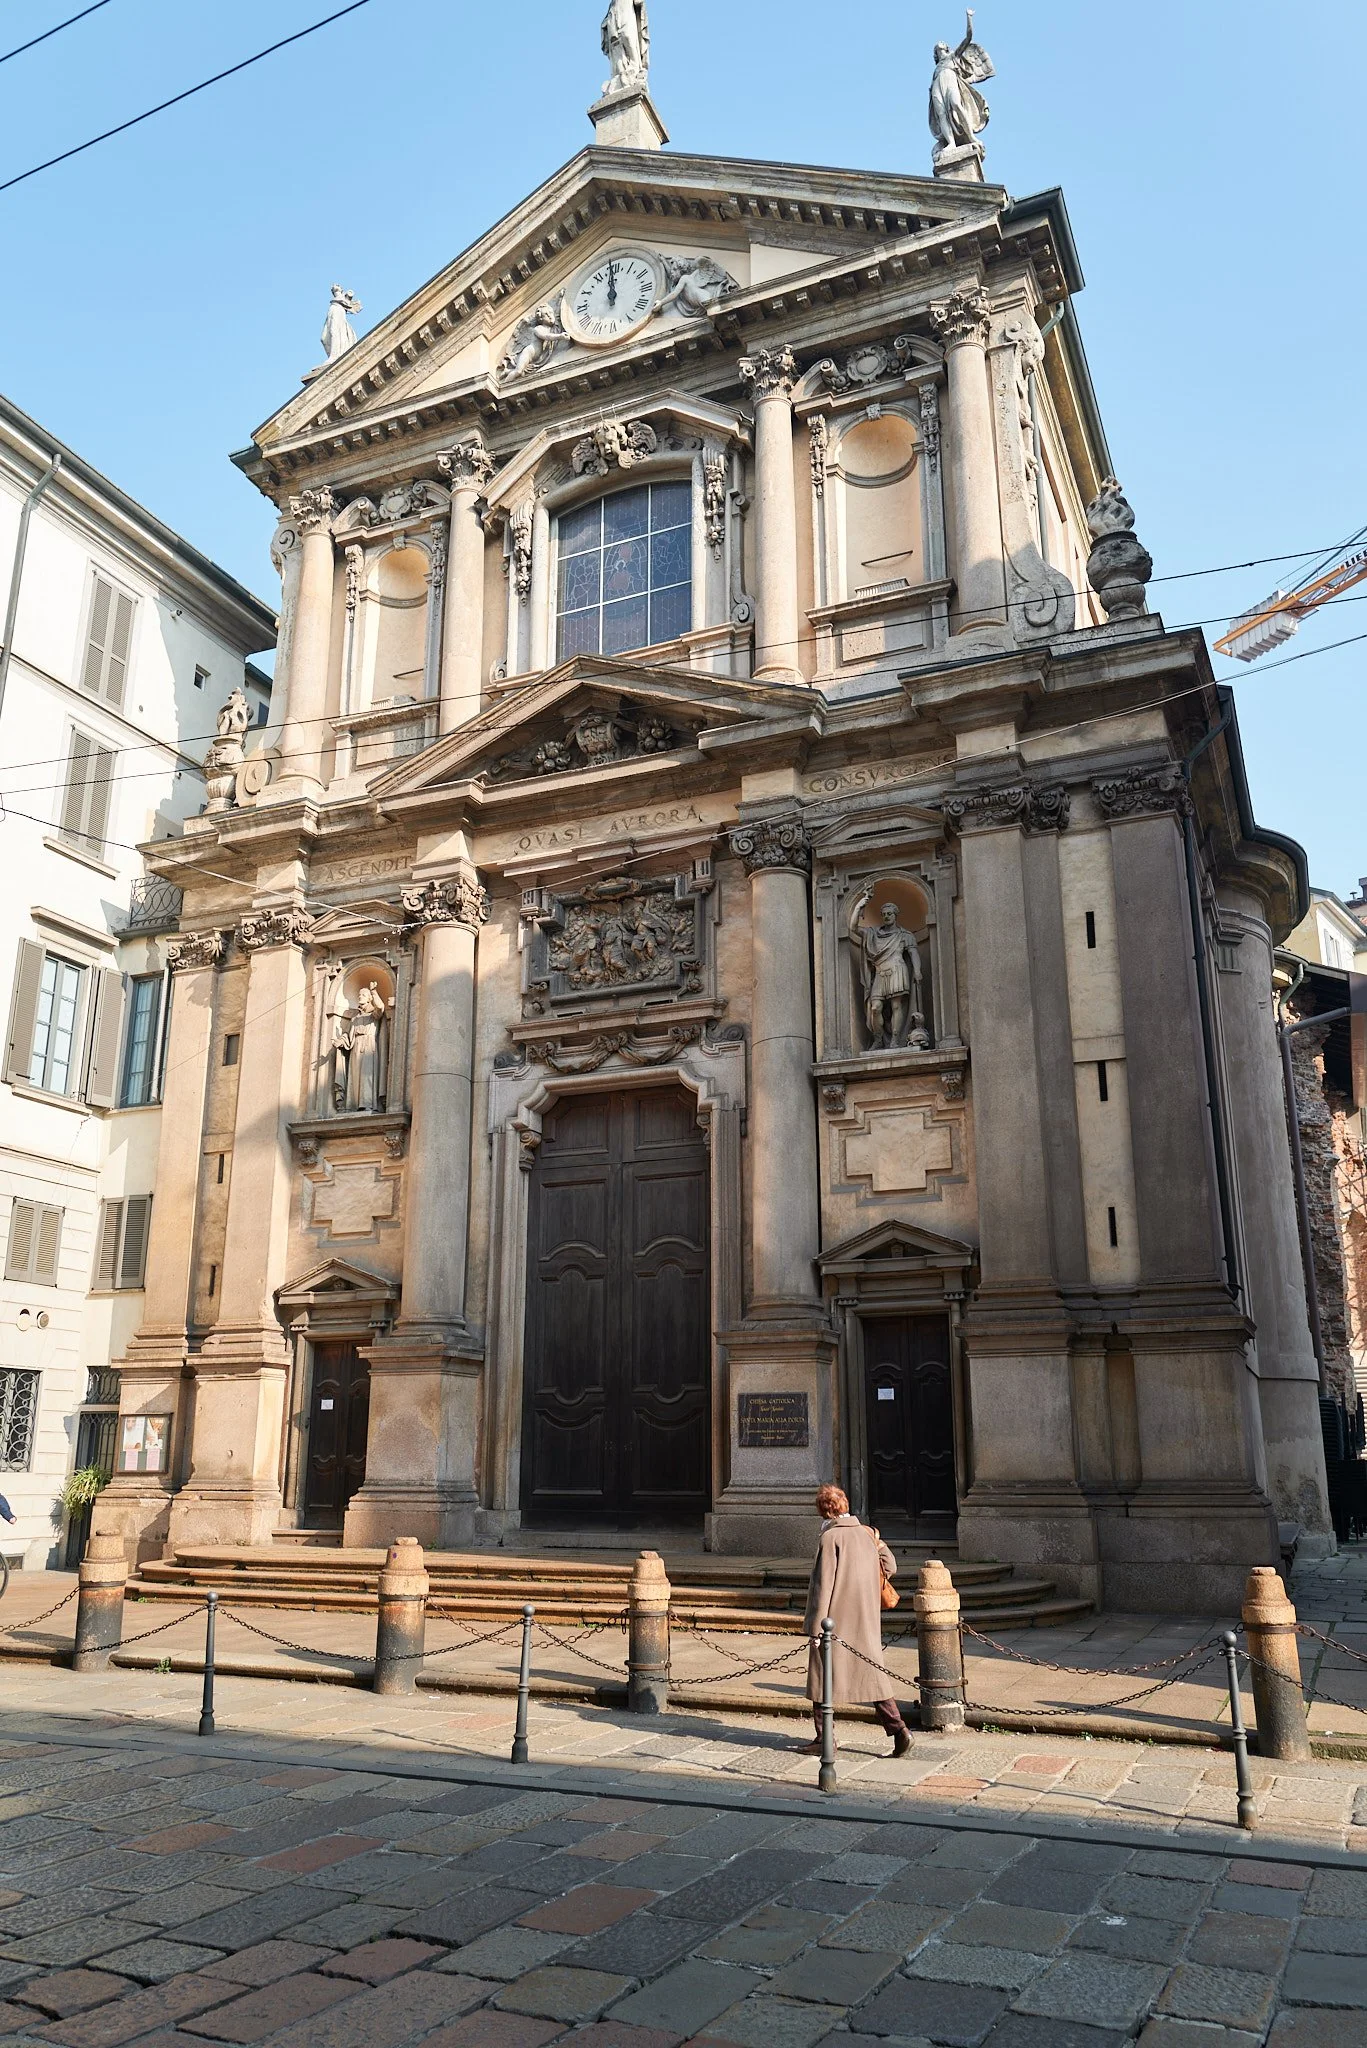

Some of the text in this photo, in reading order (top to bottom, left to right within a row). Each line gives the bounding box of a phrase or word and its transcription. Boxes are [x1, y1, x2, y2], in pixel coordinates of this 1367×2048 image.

[518, 804, 699, 851] QVASI AVRORA
[325, 855, 412, 882] ASCENDIT
